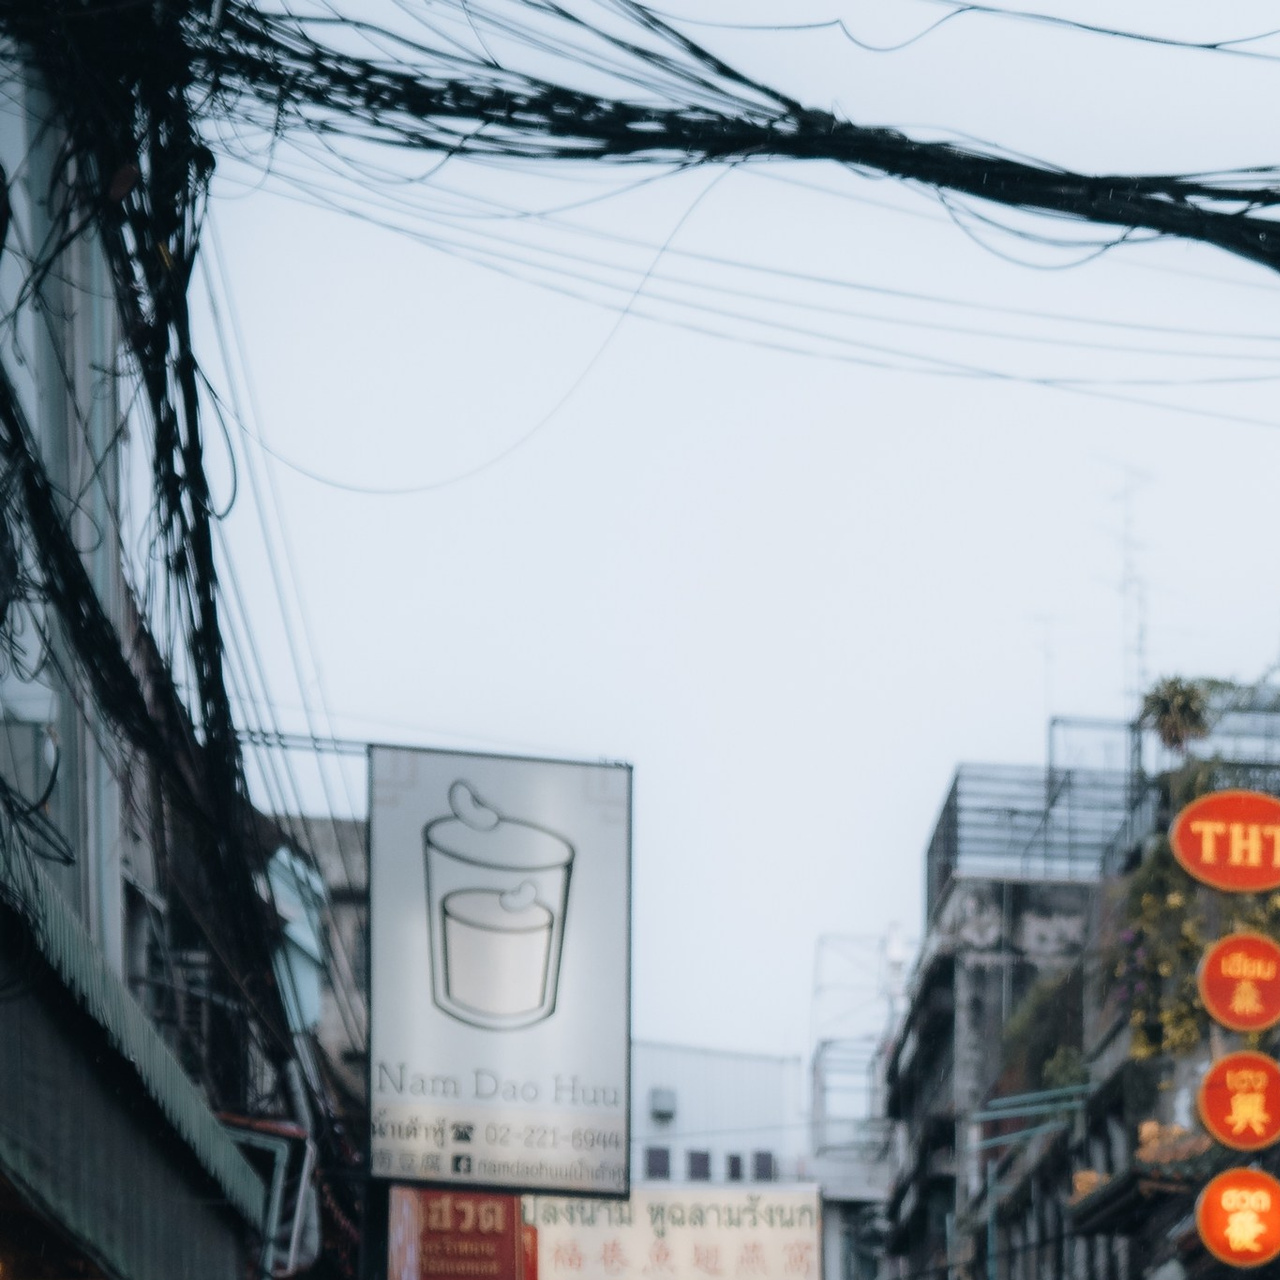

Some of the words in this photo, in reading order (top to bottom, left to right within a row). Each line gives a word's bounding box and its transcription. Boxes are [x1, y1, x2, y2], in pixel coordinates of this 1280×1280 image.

[377, 1062, 460, 1099] Nam
[473, 1068, 539, 1104] Dao
[553, 1073, 619, 1108] Huu
